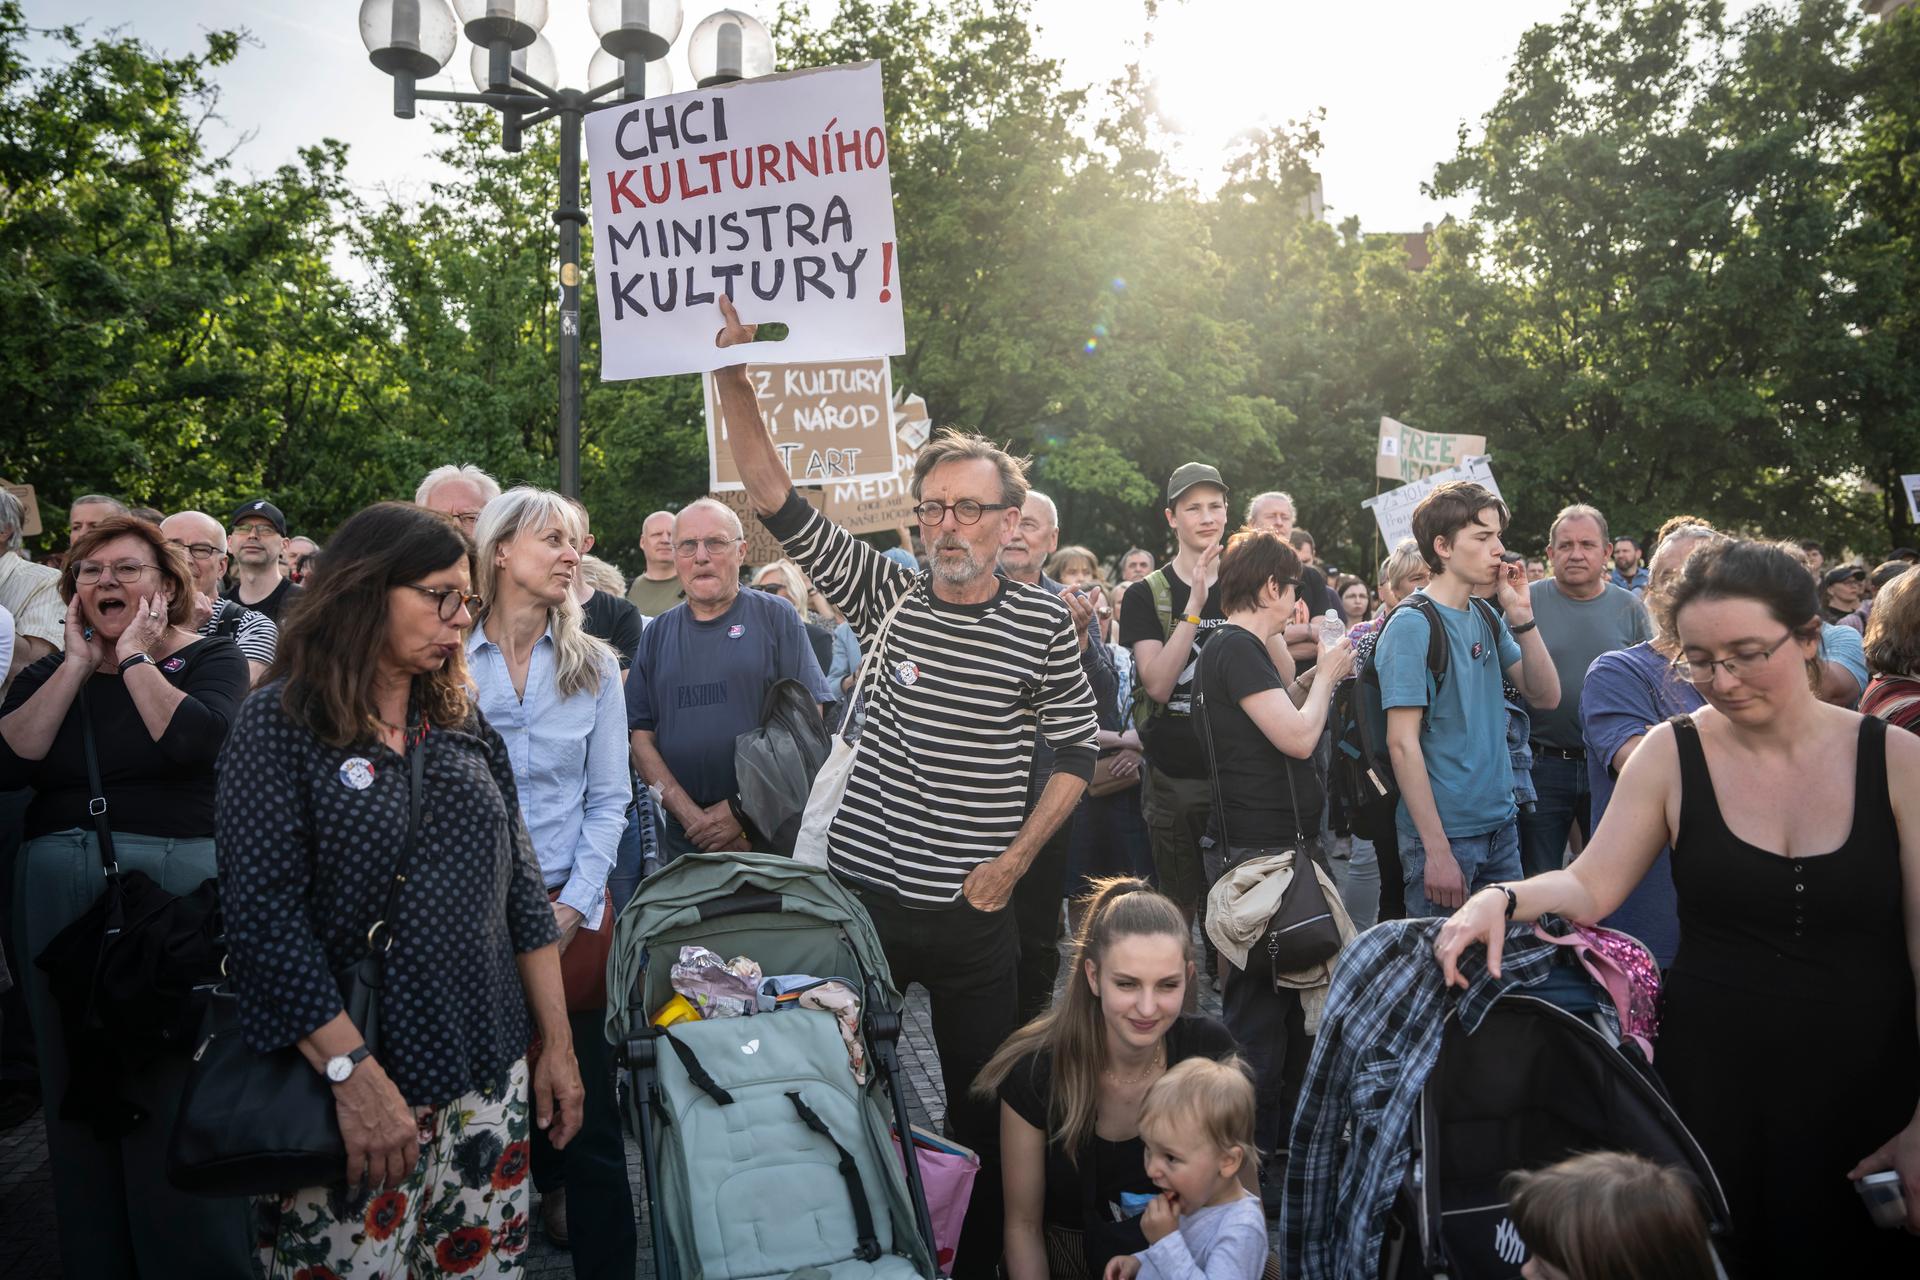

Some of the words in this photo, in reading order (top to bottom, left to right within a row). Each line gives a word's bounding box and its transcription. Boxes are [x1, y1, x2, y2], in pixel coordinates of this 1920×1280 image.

[615, 97, 728, 160] CHCI
[607, 117, 886, 214] KULTURNÍHO
[608, 195, 853, 265] MINISTRA
[785, 367, 885, 396] KULTURY
[793, 397, 880, 432] NÁROD
[806, 447, 862, 479] ART
[1400, 426, 1457, 464] FREE
[678, 680, 728, 709] FASHION
